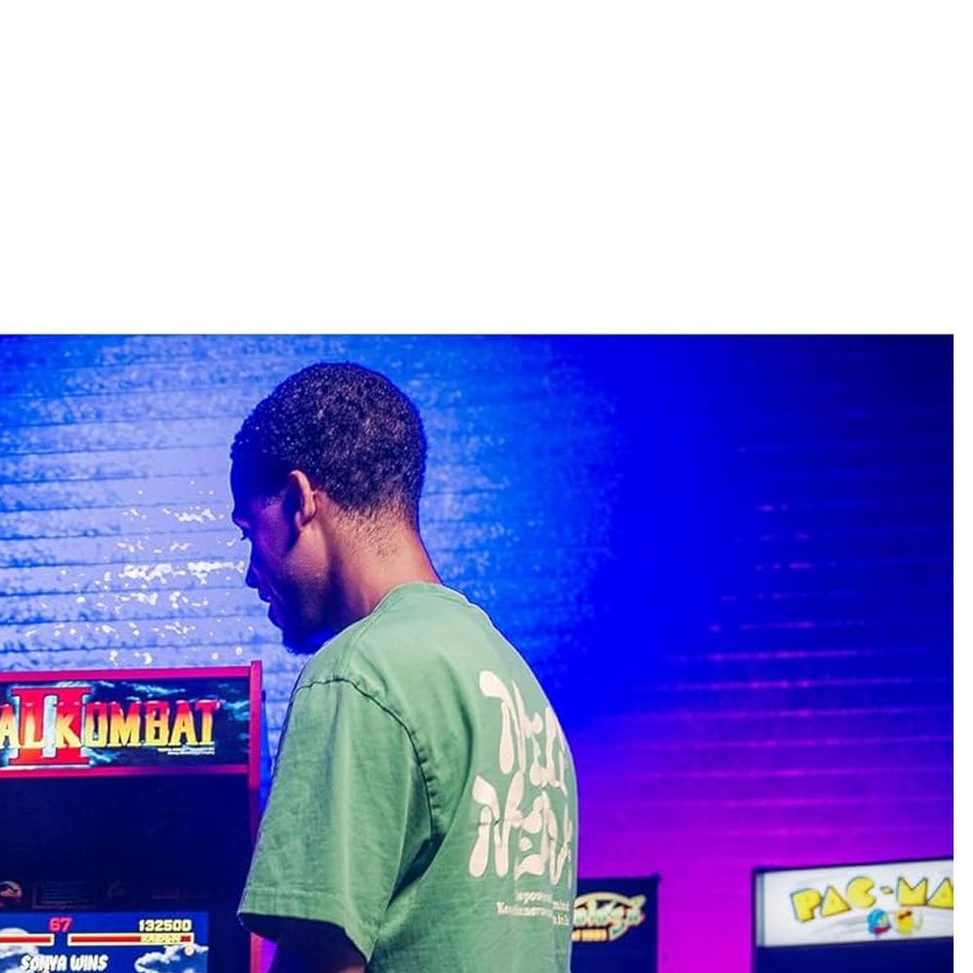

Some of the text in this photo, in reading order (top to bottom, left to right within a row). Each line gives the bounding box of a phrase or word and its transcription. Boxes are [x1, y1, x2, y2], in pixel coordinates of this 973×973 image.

[55, 700, 221, 748] KOMBAT
[790, 874, 953, 923] PAC-MA
[49, 917, 72, 932] 67
[139, 919, 192, 932] 132500
[21, 953, 109, 972] SONYA WINS
